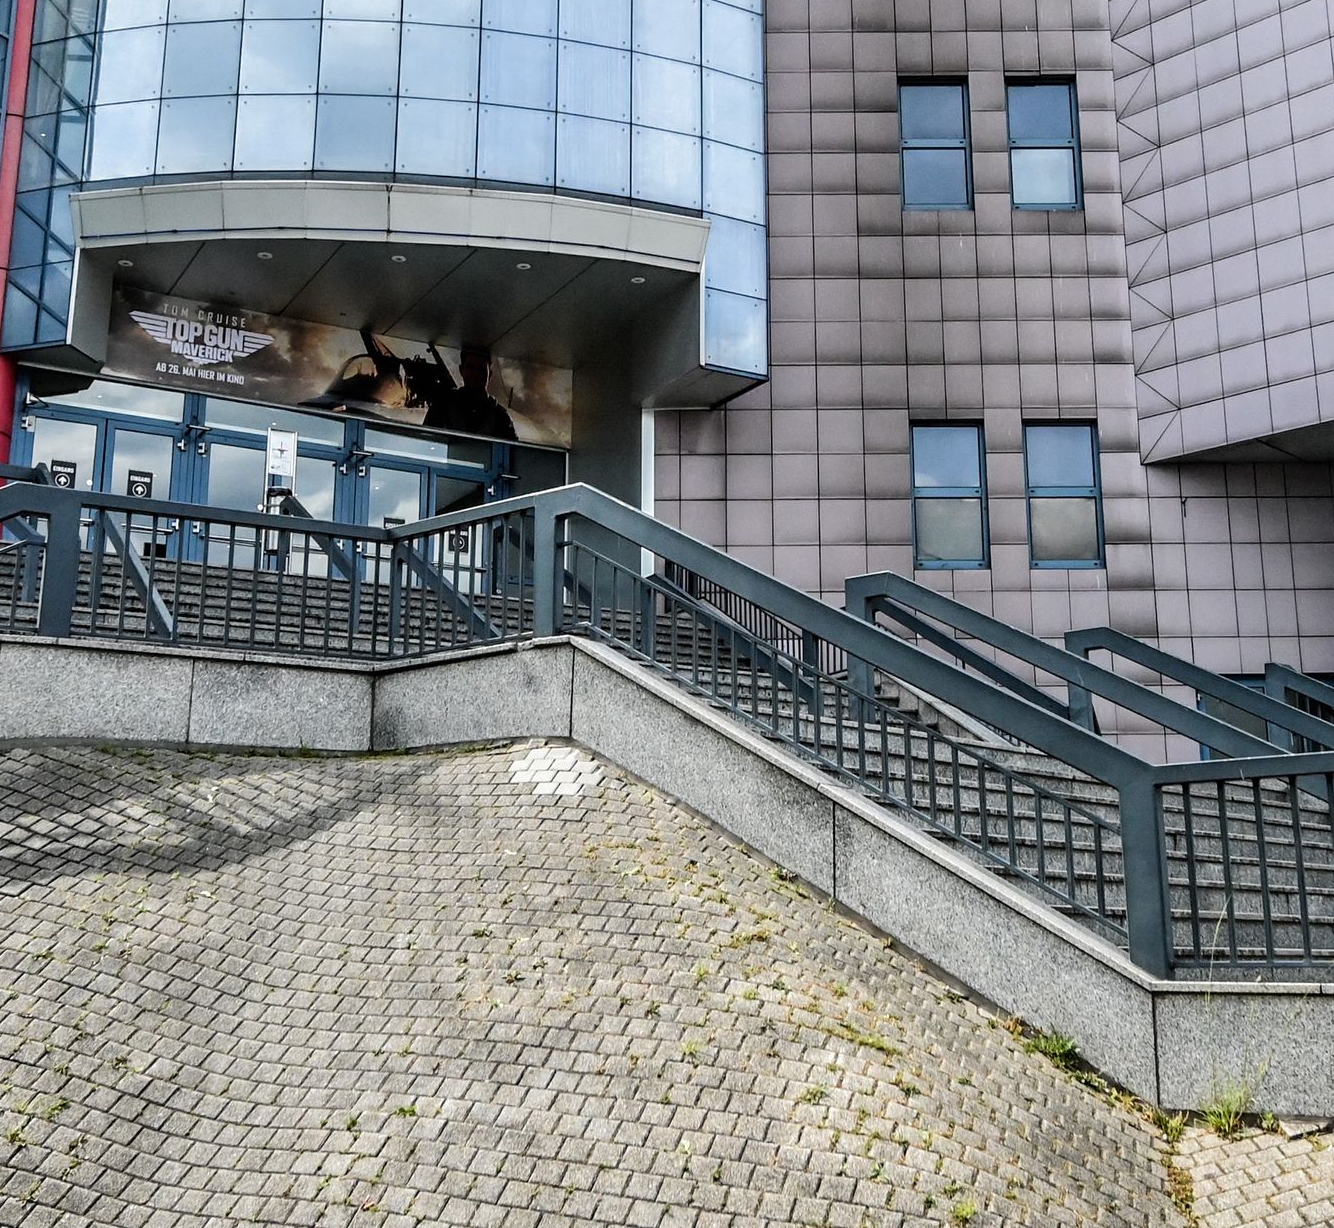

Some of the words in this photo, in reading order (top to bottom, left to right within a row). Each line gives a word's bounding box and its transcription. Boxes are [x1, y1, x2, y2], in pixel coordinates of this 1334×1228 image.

[163, 303, 189, 318] TOM
[198, 311, 247, 328] CRUISE
[167, 318, 203, 343] TOP
[204, 325, 245, 352] GUN
[171, 341, 234, 363] MAVERICK
[156, 362, 166, 372] AB
[168, 364, 180, 375] 26.
[183, 366, 196, 377] MAI
[198, 369, 214, 380] HIER
[217, 372, 226, 382] IM
[227, 373, 245, 385] KINO
